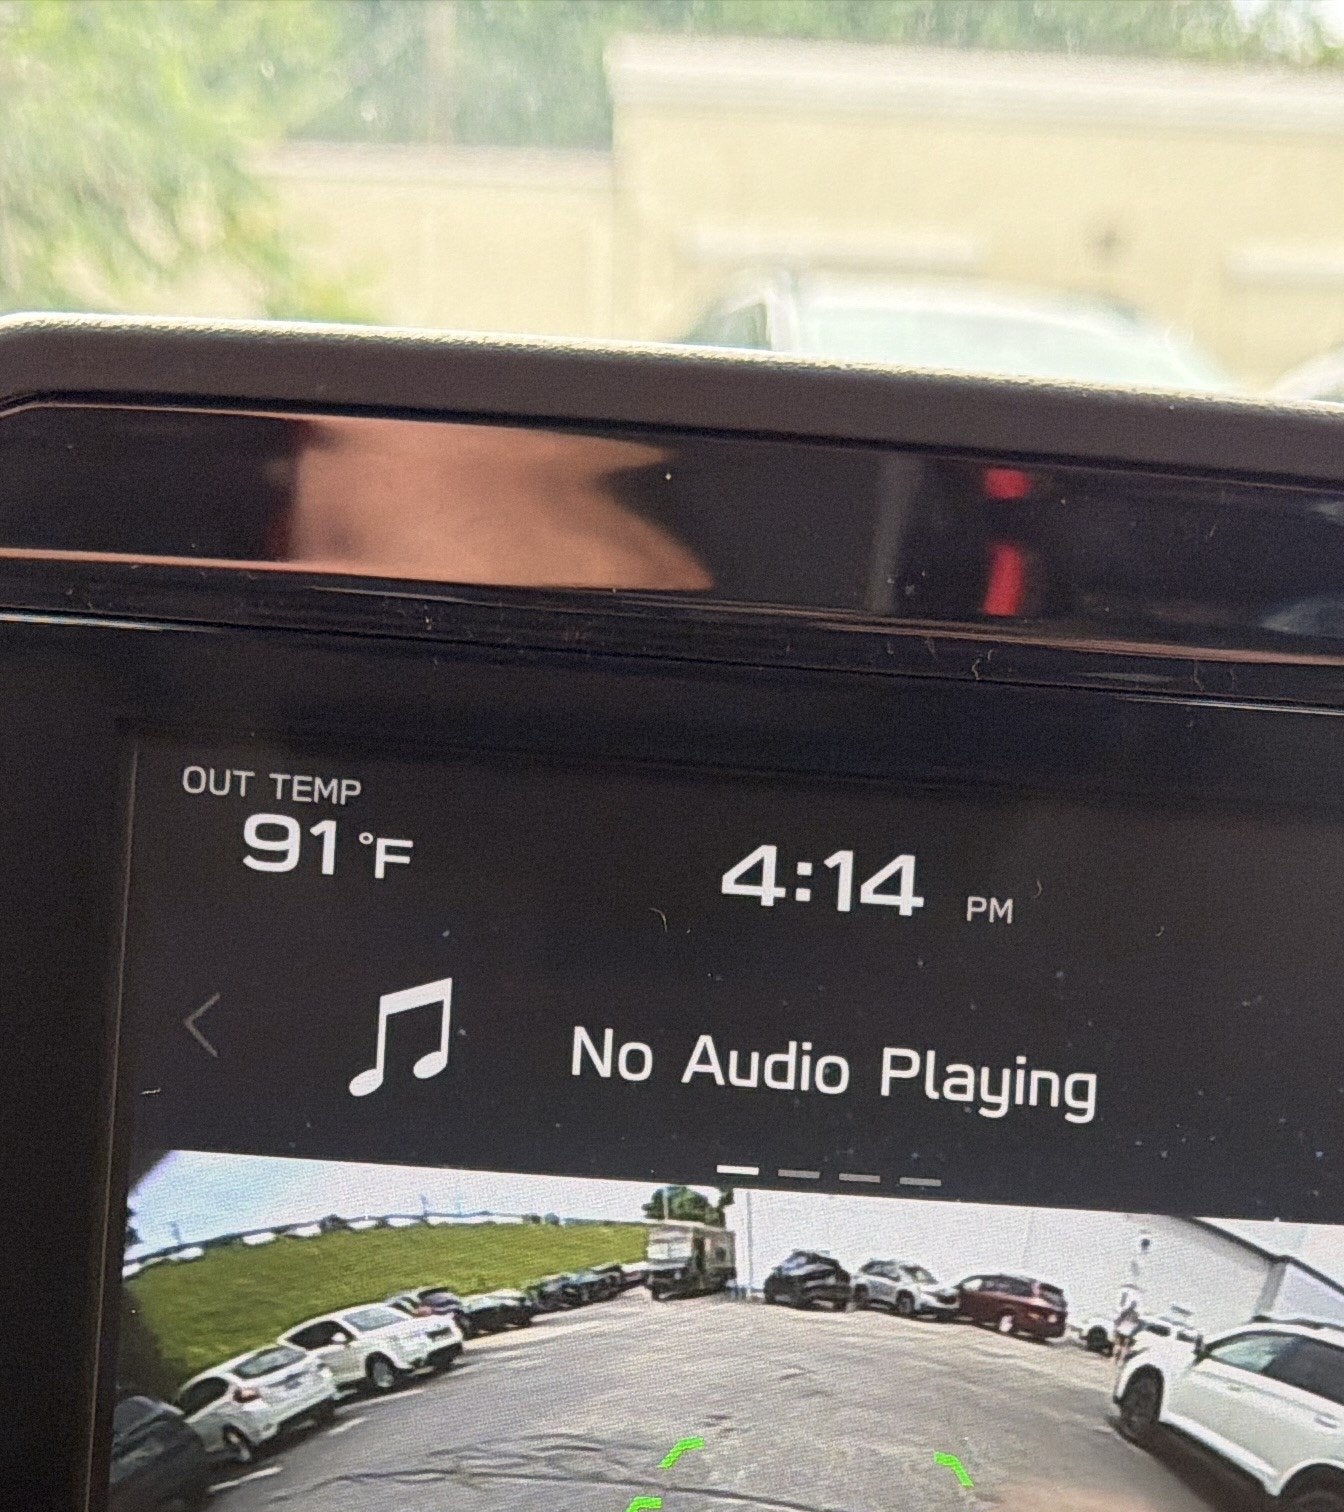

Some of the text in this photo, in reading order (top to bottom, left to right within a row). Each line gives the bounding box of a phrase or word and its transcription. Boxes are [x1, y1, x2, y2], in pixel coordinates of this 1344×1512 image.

[182, 765, 362, 805] OUT TEMP
[721, 844, 1014, 924] 4:14 PM
[571, 1025, 1097, 1124] No Audio Playing
